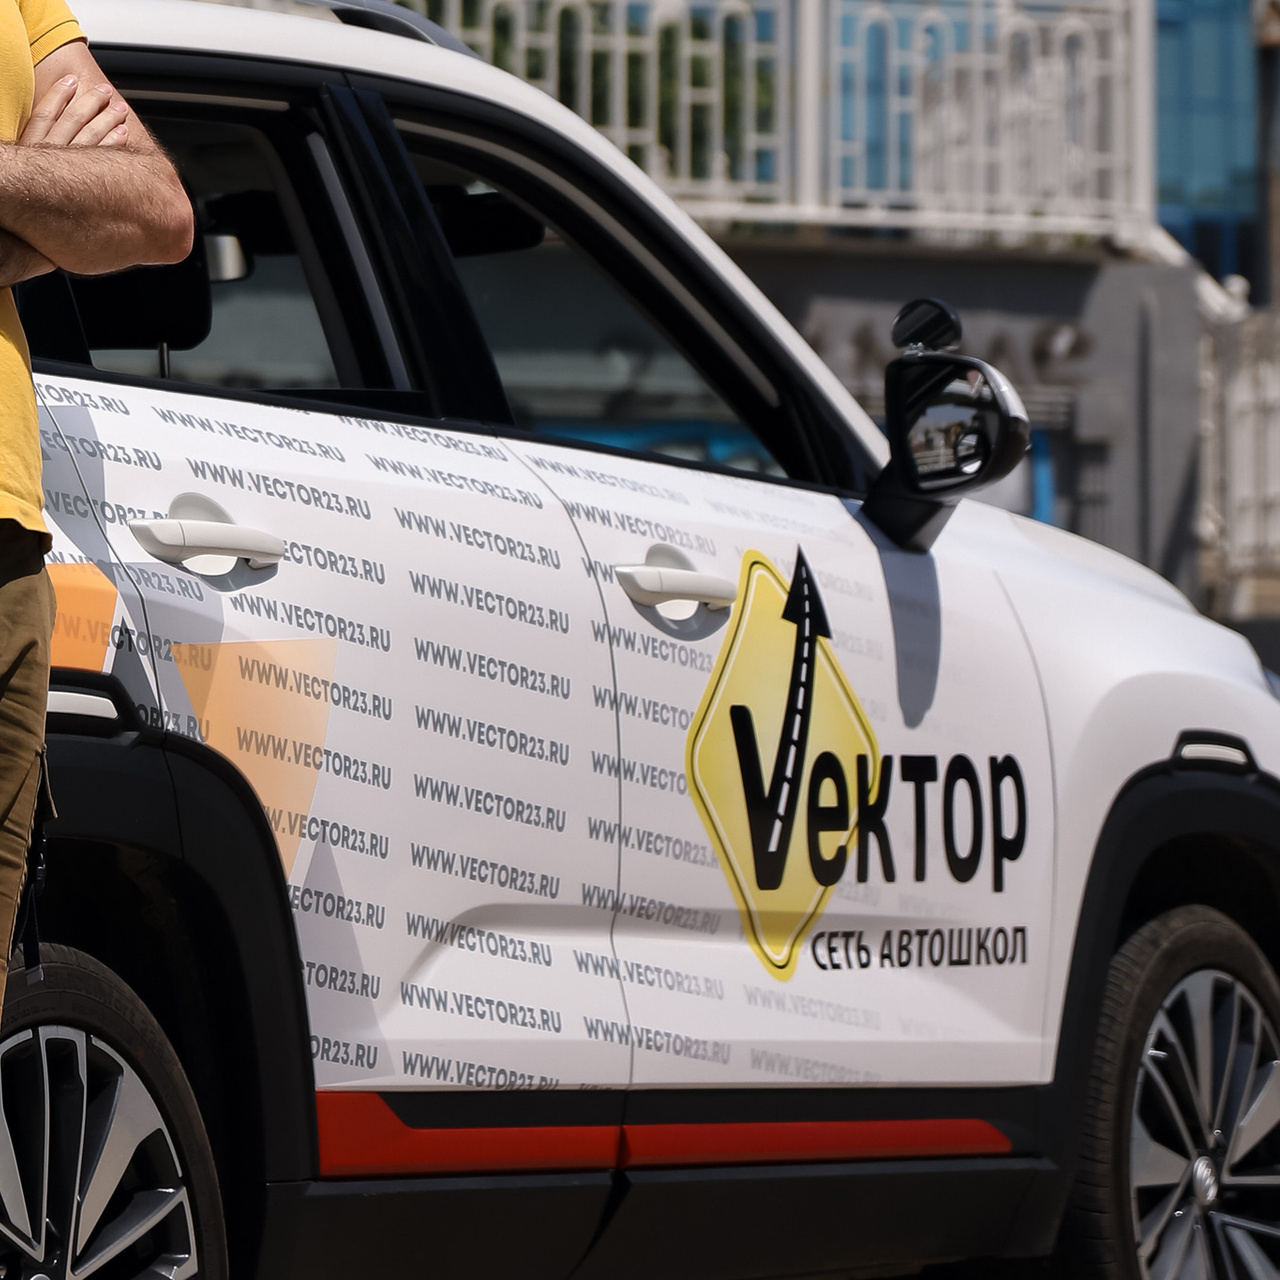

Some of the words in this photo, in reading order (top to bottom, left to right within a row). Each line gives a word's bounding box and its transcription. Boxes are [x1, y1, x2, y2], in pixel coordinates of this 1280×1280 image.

[151, 406, 346, 463] WWW.VECTOR23.RU
[185, 457, 372, 521] WWW.VECTOR23.RU
[365, 453, 544, 510] WWW.VECTOR23.RU
[394, 507, 562, 570] WWW.VECTOR23.RU
[230, 593, 392, 653] WWW.VECTOR23.RU
[409, 570, 570, 635] WWW.VECTOR23.RU
[239, 656, 393, 721] WWW.VECTOR23.RU
[414, 637, 571, 700] WWW.VECTOR23.RU
[236, 726, 392, 790] WWW.VECTOR23.RU
[415, 705, 570, 766] WWW.VECTOR23.RU
[414, 773, 567, 833] WWW.VECTOR23.RU
[410, 842, 561, 900] WWW.VECTOR23.RU
[406, 911, 553, 967] WWW.VECTOR23.RU
[811, 931, 871, 970] СЕТЬ
[880, 925, 1028, 968] АВТОШКОЛ
[573, 950, 724, 1001] WWW.VECTOR23.RU
[400, 981, 563, 1034] WWW.VECTOR23.RU
[583, 1016, 732, 1065] WWW.VECTOR23.RU
